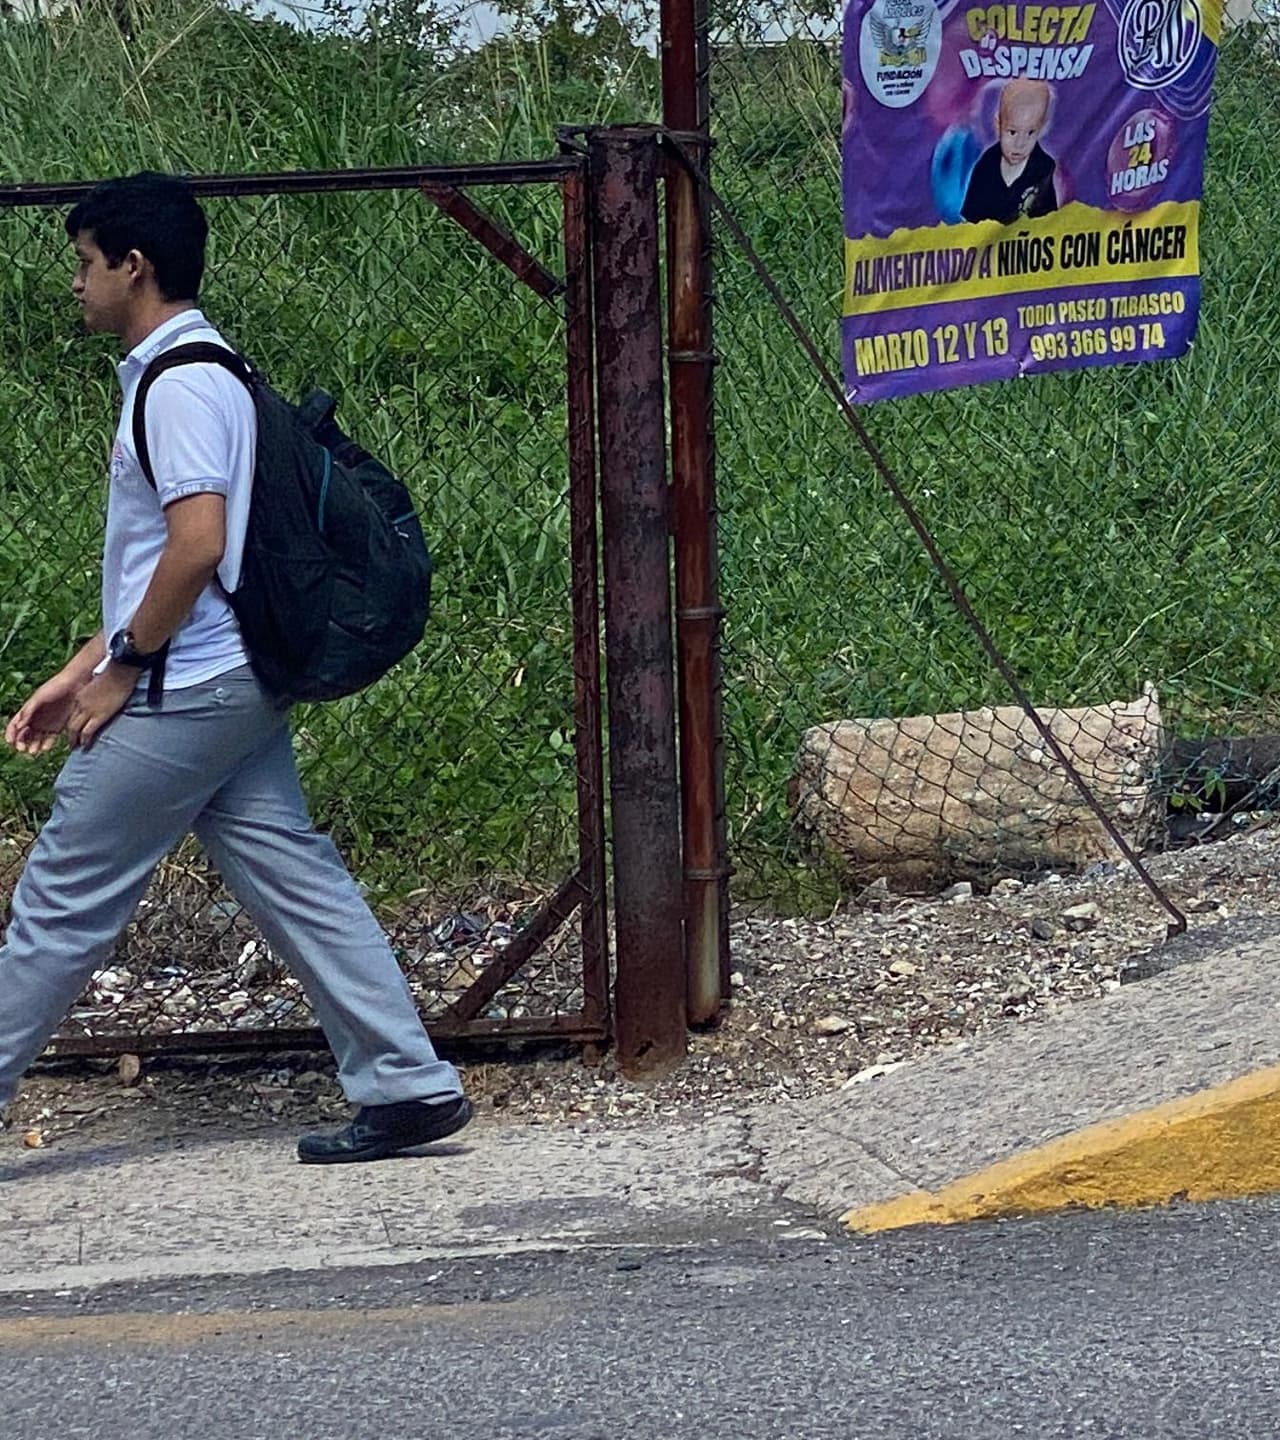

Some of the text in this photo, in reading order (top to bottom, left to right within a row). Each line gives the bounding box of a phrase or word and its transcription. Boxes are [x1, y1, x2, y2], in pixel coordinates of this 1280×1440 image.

[966, 3, 1096, 45] COLECTA
[877, 66, 923, 82] FUNDACIÓN
[959, 44, 1094, 80] DESPENSA
[1124, 120, 1156, 148] LAS
[1128, 146, 1152, 167] 24
[1110, 159, 1169, 196] HORAS
[853, 220, 1187, 297] ALIMENTANDO A NIÑOS CON CÁNCER
[1017, 291, 1186, 329] TODO PASEO TABASCO
[854, 316, 1009, 377] MARZO 12 Y 13
[1030, 322, 1166, 361] 993 366 99 74
